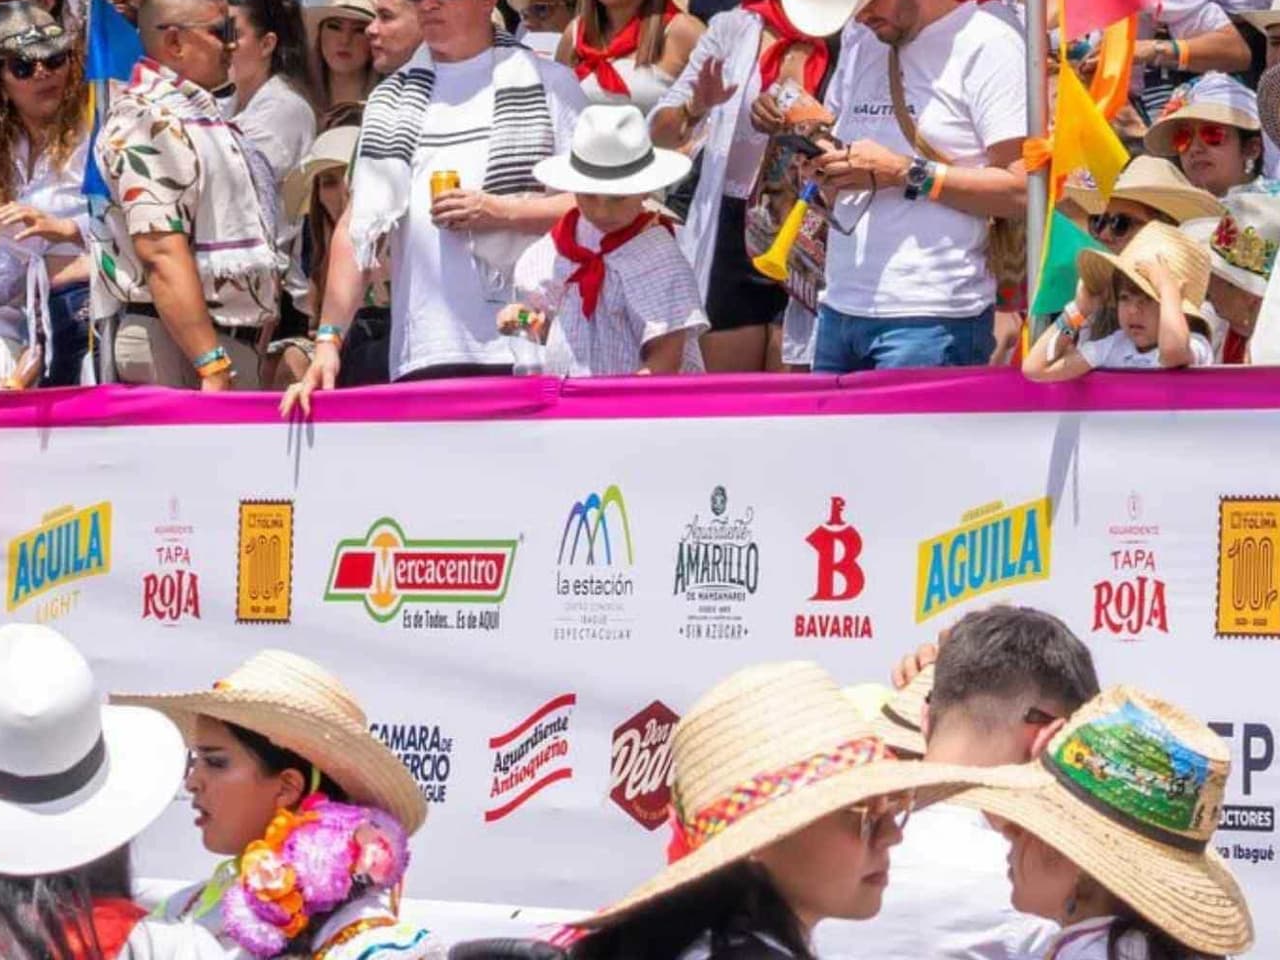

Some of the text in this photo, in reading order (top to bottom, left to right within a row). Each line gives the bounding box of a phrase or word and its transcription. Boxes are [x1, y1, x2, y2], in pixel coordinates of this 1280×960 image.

[156, 546, 191, 567] TAPA
[374, 551, 498, 593] Mercacentro
[674, 542, 759, 595] AMARILLO
[923, 507, 1042, 614] AGUILA
[1110, 549, 1156, 571] TAPA
[142, 570, 200, 620] ROJA
[556, 570, 634, 596] la estación
[1092, 576, 1168, 634] ROJA
[794, 615, 873, 638] BAVARIA
[490, 736, 568, 798] Antioqueño
[494, 716, 569, 774] Aguardiente
